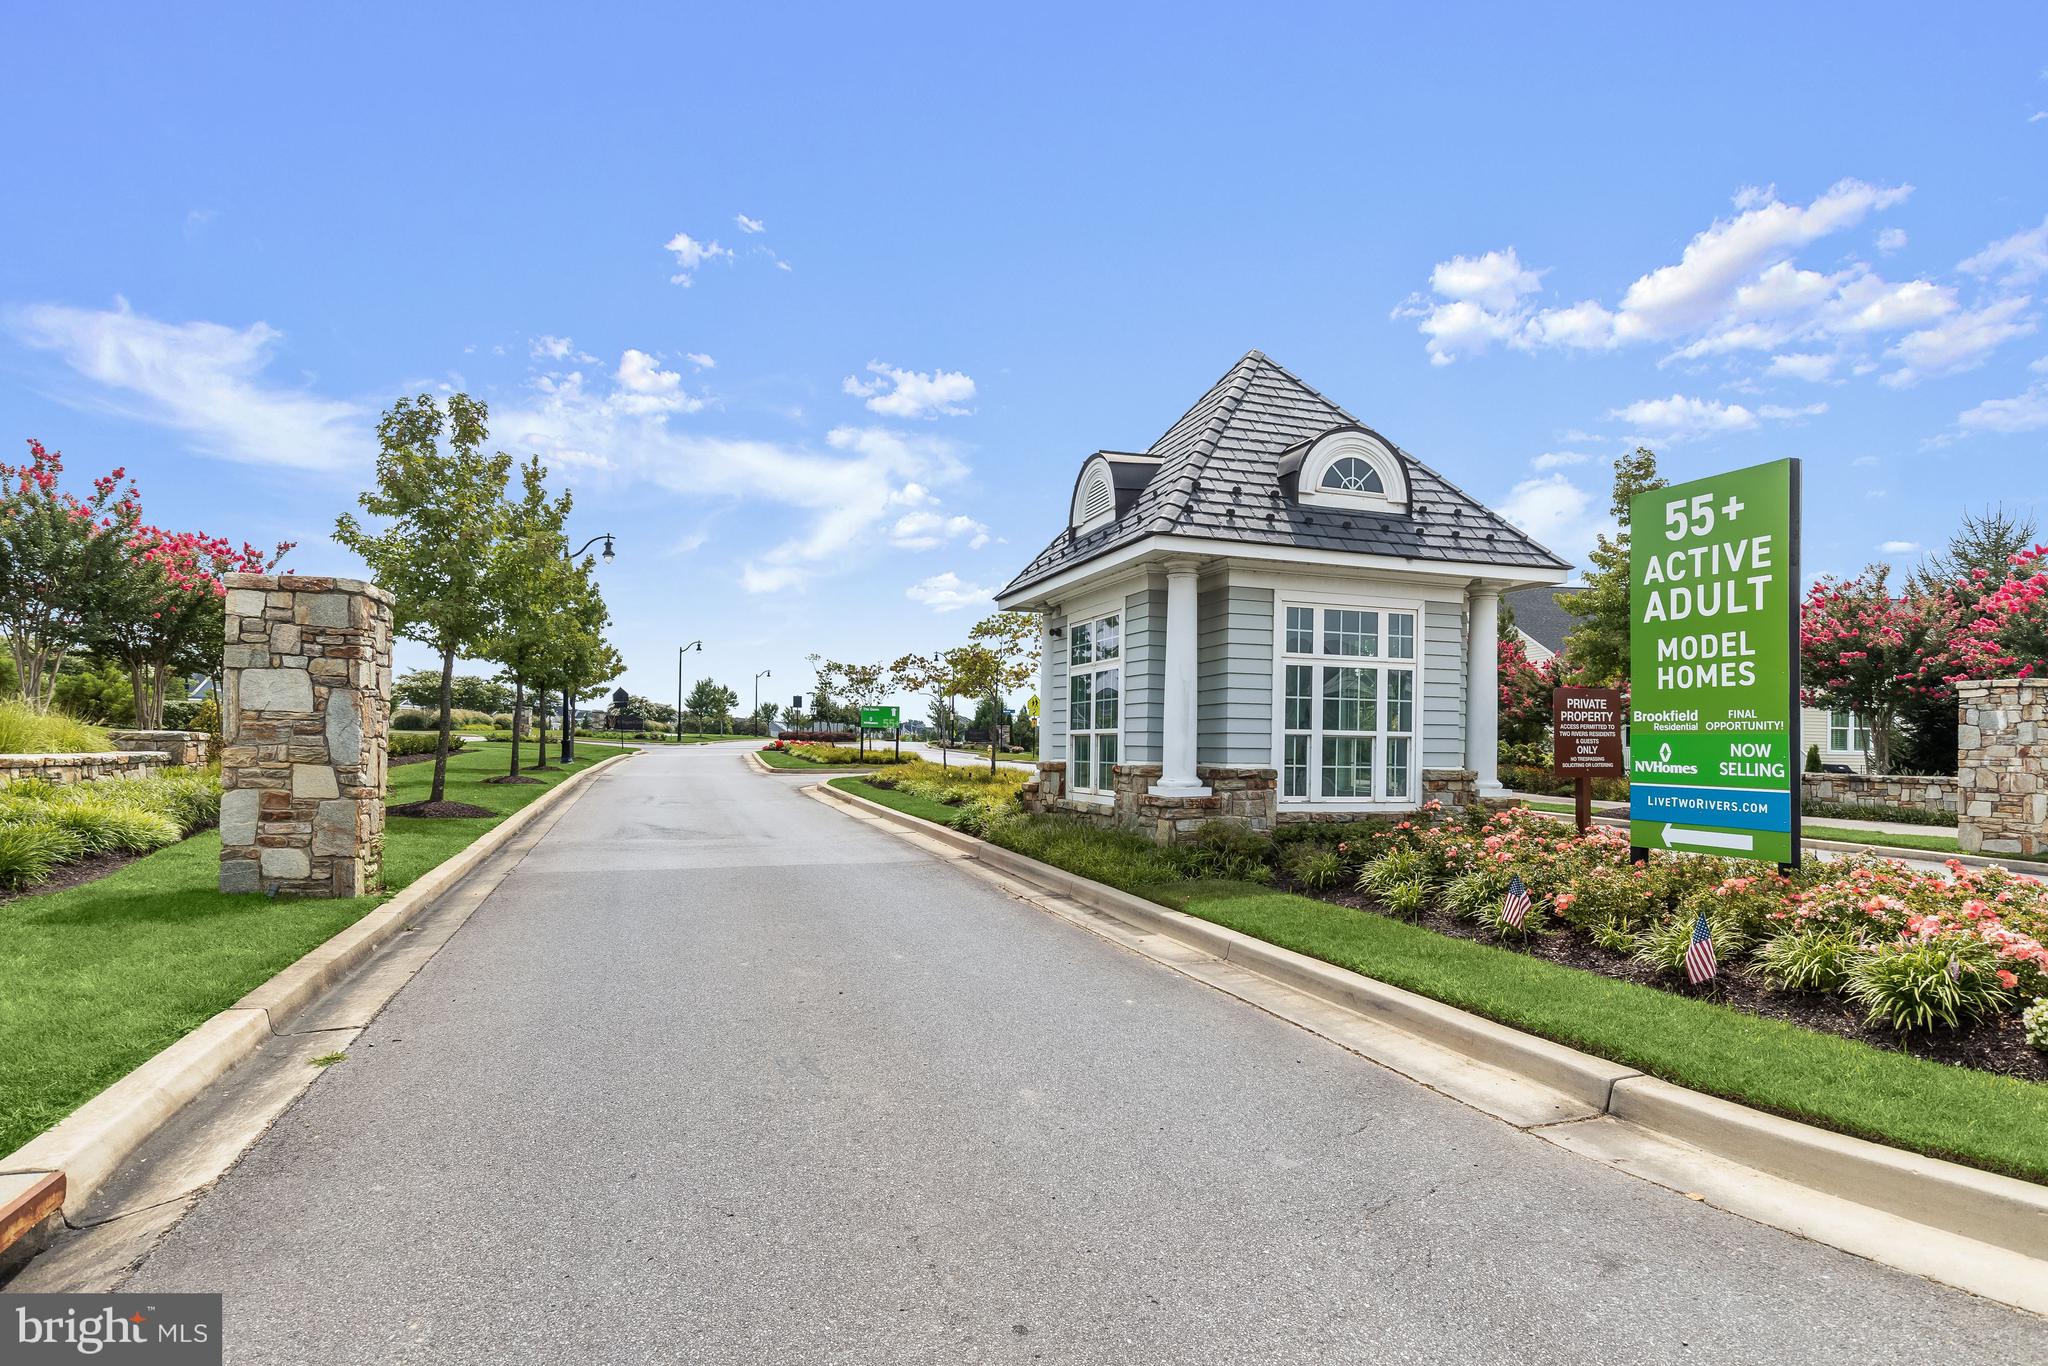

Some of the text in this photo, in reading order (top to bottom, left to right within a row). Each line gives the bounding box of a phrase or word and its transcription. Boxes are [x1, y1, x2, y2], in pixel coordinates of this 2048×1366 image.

[1643, 534, 1773, 586] ACTIVE
[1643, 574, 1773, 624] ADULT
[1657, 630, 1757, 662] MODEL
[1657, 661, 1757, 690] HOMES
[1567, 698, 1607, 709] PRIVATE
[1560, 711, 1613, 722] PROPERTY
[1633, 709, 1699, 722] Brookfield
[1728, 709, 1757, 719] FINAL
[1653, 722, 1699, 731] Residential
[1705, 720, 1784, 731] OPPORTUNITY!
[1577, 745, 1598, 754] ONLY
[1730, 743, 1772, 758] NOW
[1635, 760, 1698, 775] NVHomes
[1719, 761, 1785, 778] SELLING
